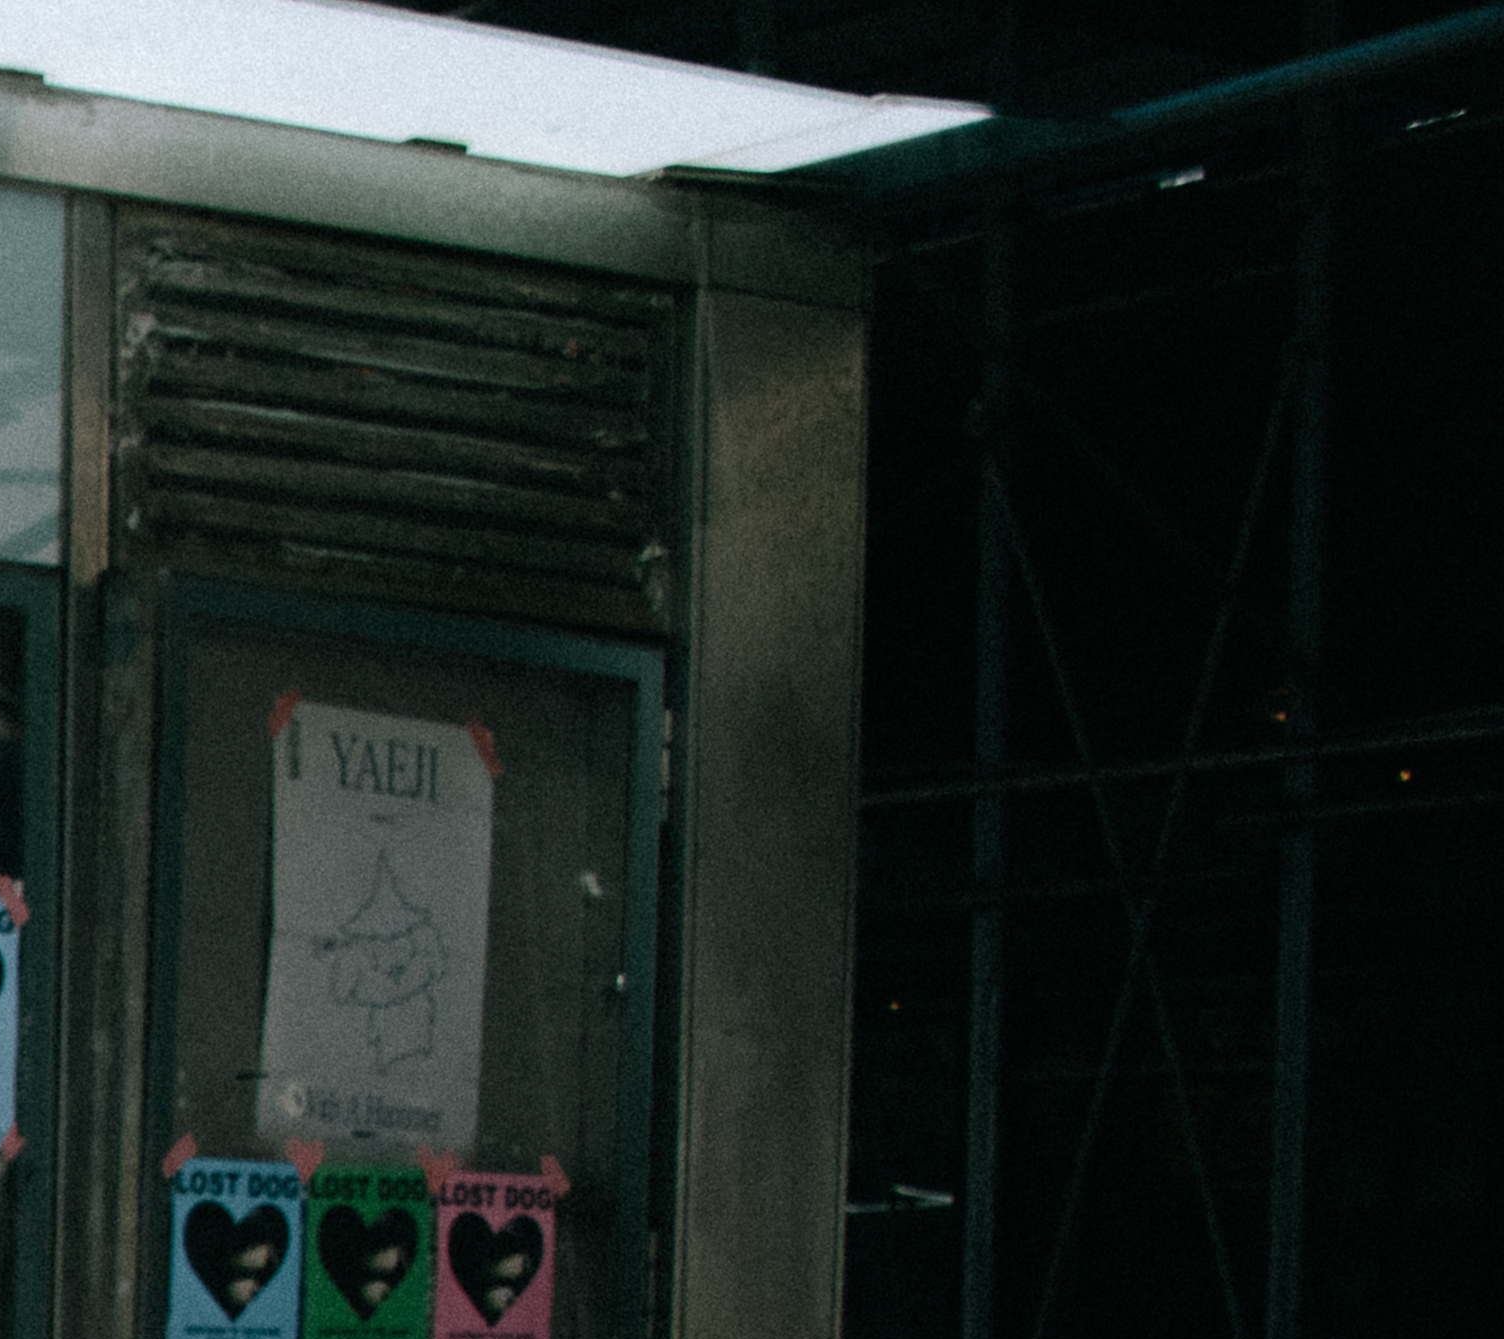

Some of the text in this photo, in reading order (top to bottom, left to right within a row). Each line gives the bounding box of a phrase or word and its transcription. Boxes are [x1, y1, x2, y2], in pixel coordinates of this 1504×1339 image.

[333, 731, 438, 800] YAEJI
[175, 1171, 301, 1199] LOST DOG
[309, 1171, 428, 1201] LOST DOG
[440, 1182, 552, 1210] LOST DOG
